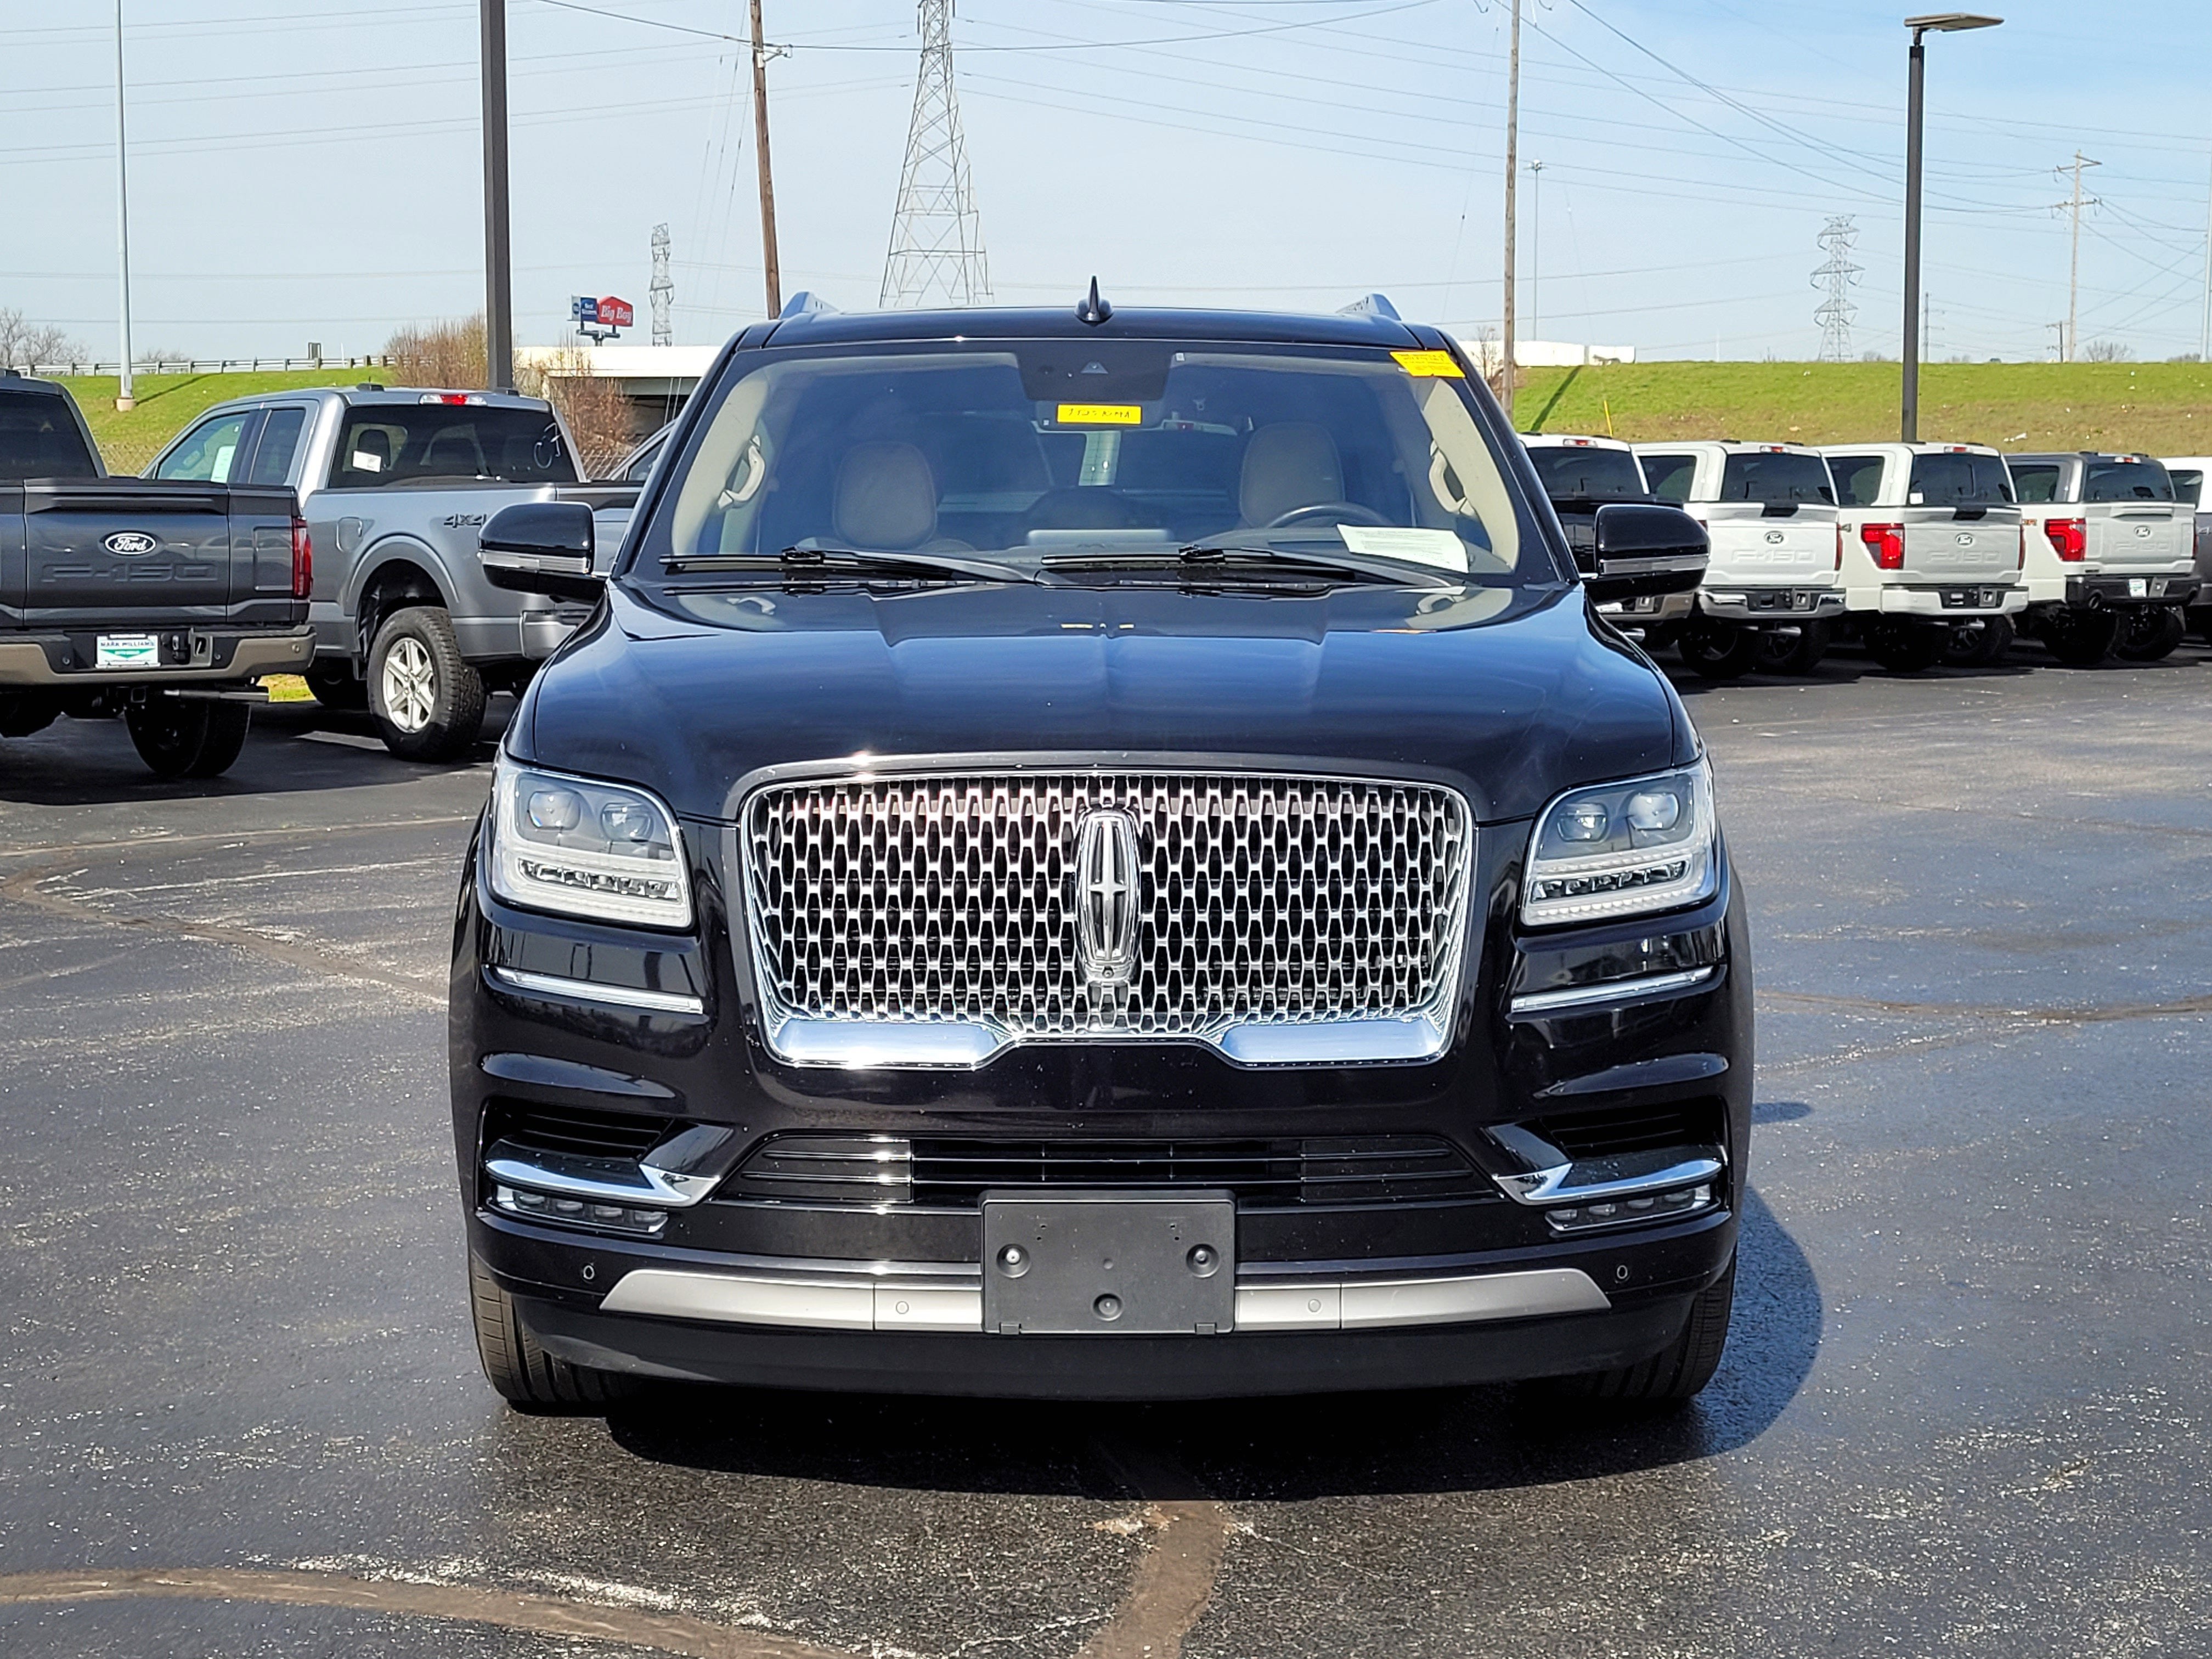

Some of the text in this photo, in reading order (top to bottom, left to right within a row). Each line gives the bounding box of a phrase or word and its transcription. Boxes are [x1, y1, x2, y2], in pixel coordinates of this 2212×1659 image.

[601, 305, 633, 323] Big Boy
[114, 537, 146, 551] Ford
[1731, 549, 1816, 563] F-150
[41, 563, 218, 582] F-150
